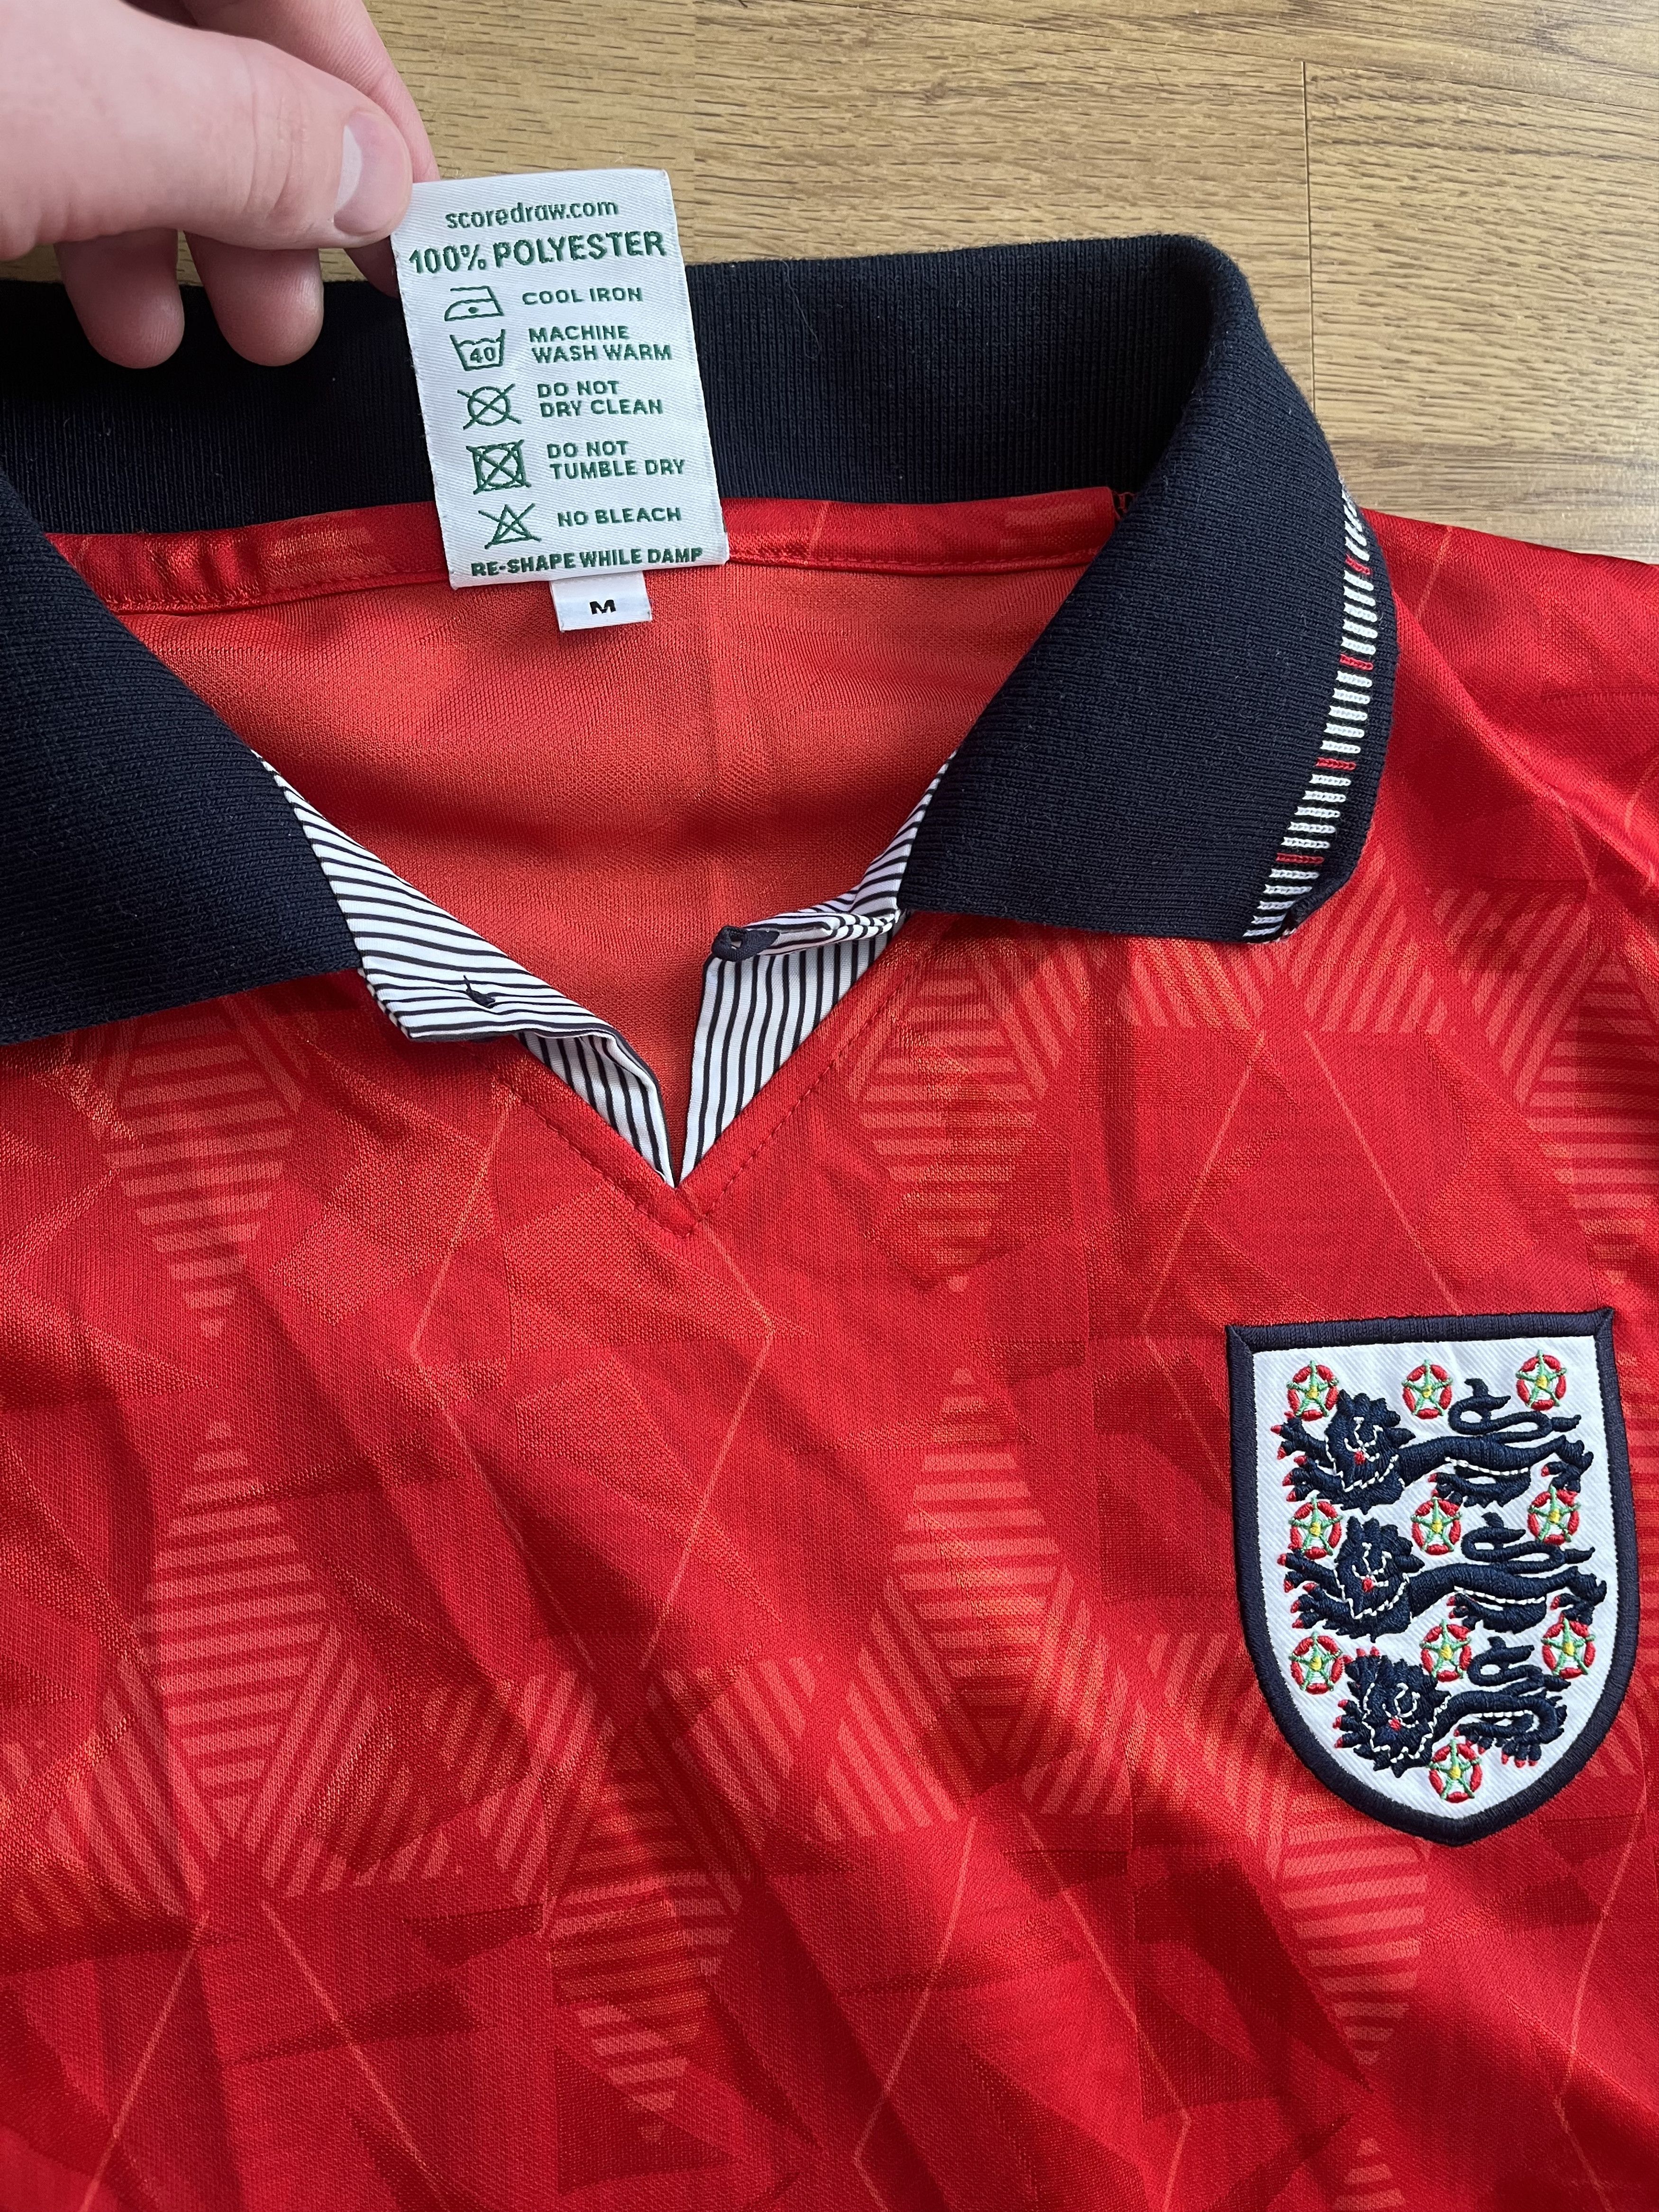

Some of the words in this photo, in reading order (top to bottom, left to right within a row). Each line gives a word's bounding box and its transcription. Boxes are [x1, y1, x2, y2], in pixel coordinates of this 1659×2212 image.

[445, 201, 619, 229] scoredraw.com
[408, 244, 487, 274] 100%
[492, 231, 667, 269] POLYESTER
[522, 290, 582, 305] COOL
[589, 287, 643, 302] IRON
[528, 325, 629, 343] MACHINE
[470, 346, 495, 364] 40
[530, 345, 598, 364] WASH
[602, 344, 672, 361] WARM
[537, 382, 569, 398] DO
[576, 380, 620, 396] NOT
[539, 400, 582, 418] DRY
[590, 399, 663, 415] CLEAN
[547, 442, 579, 459] DO
[586, 440, 629, 457] NOT
[549, 460, 638, 480] TUMBLE
[644, 459, 685, 475] DRY
[557, 510, 589, 527] NO
[594, 507, 682, 524] BLEACH
[471, 552, 576, 576] RE-SHAPE
[579, 548, 643, 568] WHILE
[647, 547, 703, 564] DAMP
[589, 599, 617, 615] M
